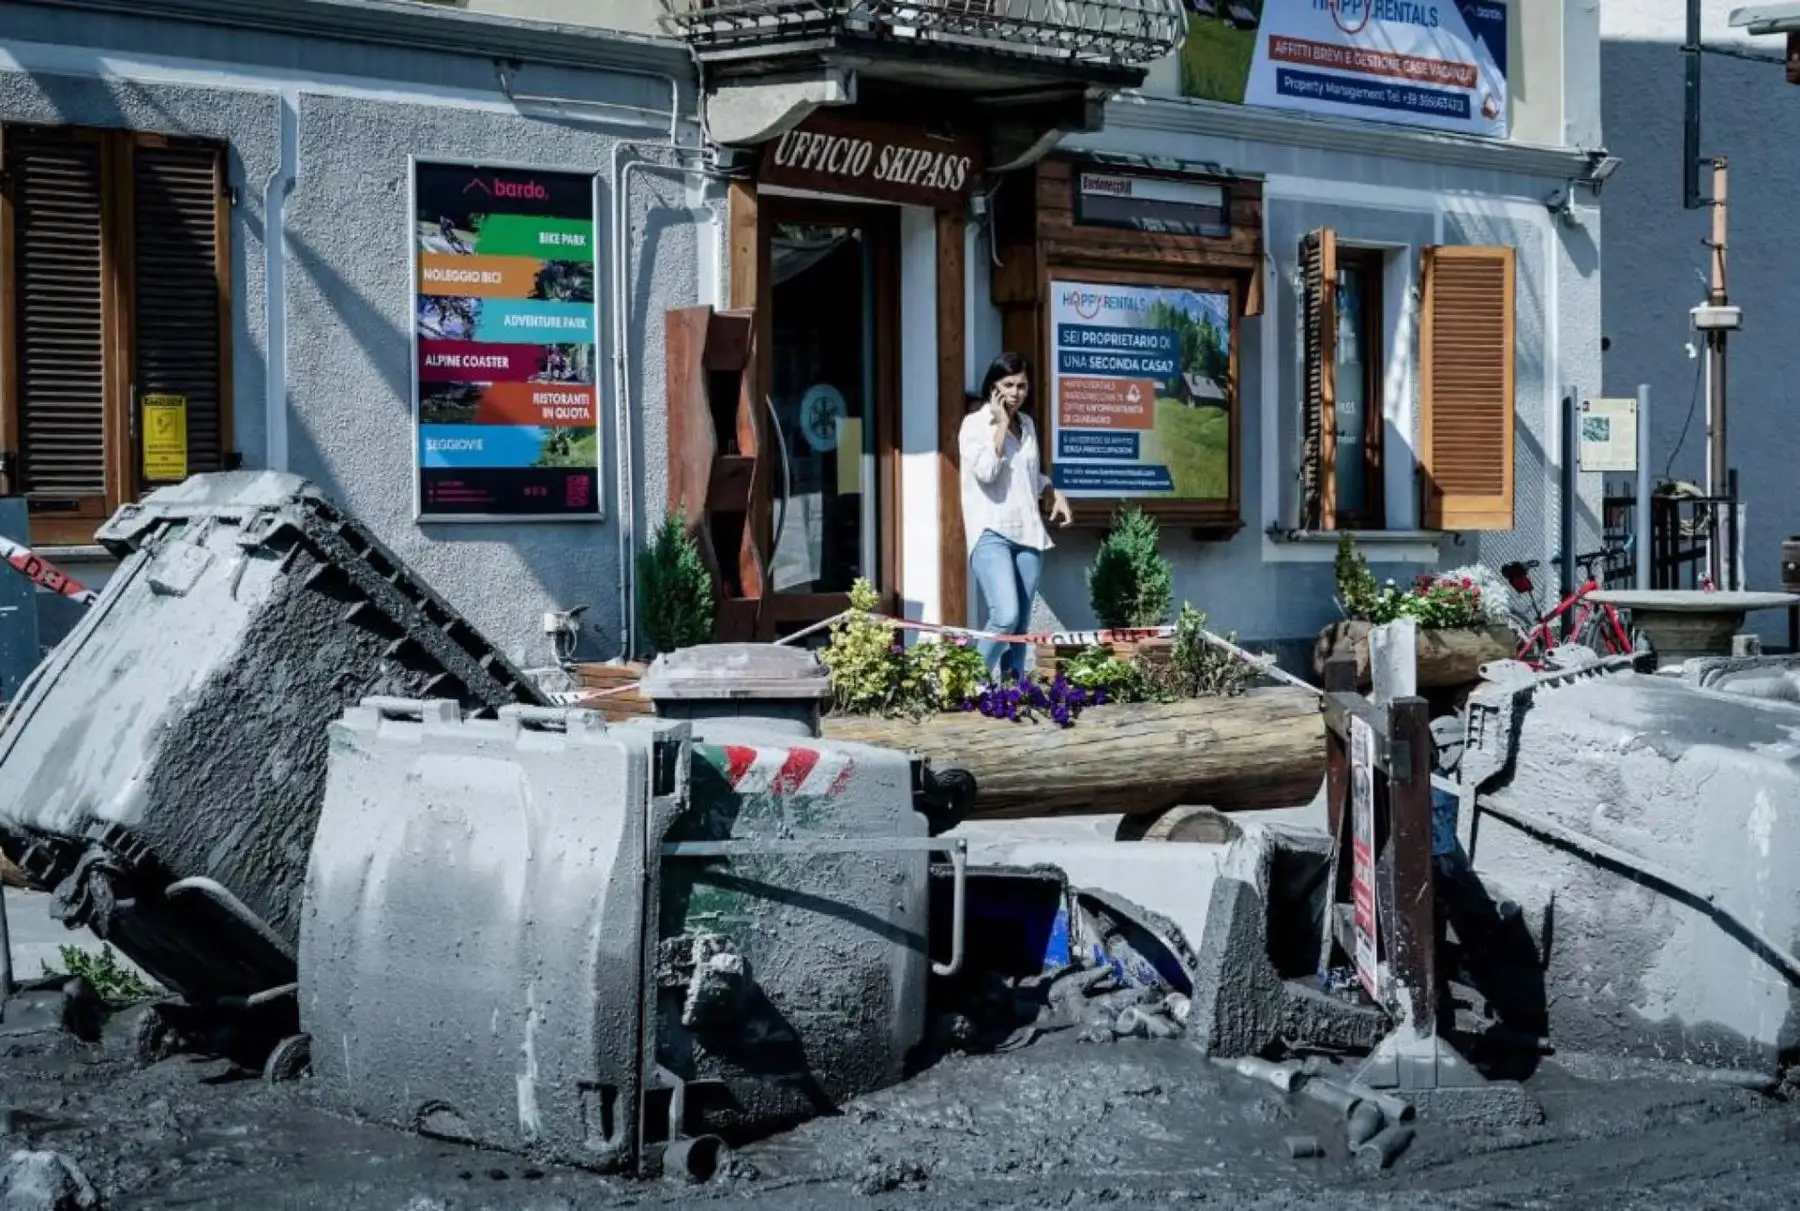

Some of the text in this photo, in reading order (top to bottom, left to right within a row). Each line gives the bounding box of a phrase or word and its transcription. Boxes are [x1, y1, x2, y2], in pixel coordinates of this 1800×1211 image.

[1284, 75, 1324, 96] Property
[774, 130, 972, 191] UFFICIO SKIPASS
[539, 231, 586, 248] BIKE PARK
[423, 268, 481, 284] NOLEGGIO
[503, 314, 588, 330] ADVENTURE PARK
[1063, 330, 1171, 349] SEI PROPRIETARIO DI
[425, 354, 510, 369] ALPINE COASTER
[1063, 355, 1174, 373] UNA SECONDA CASA?
[533, 392, 590, 405] RISTORANTI
[542, 407, 590, 420] IN QUOTA
[426, 438, 484, 451] SEGGIOVIE
